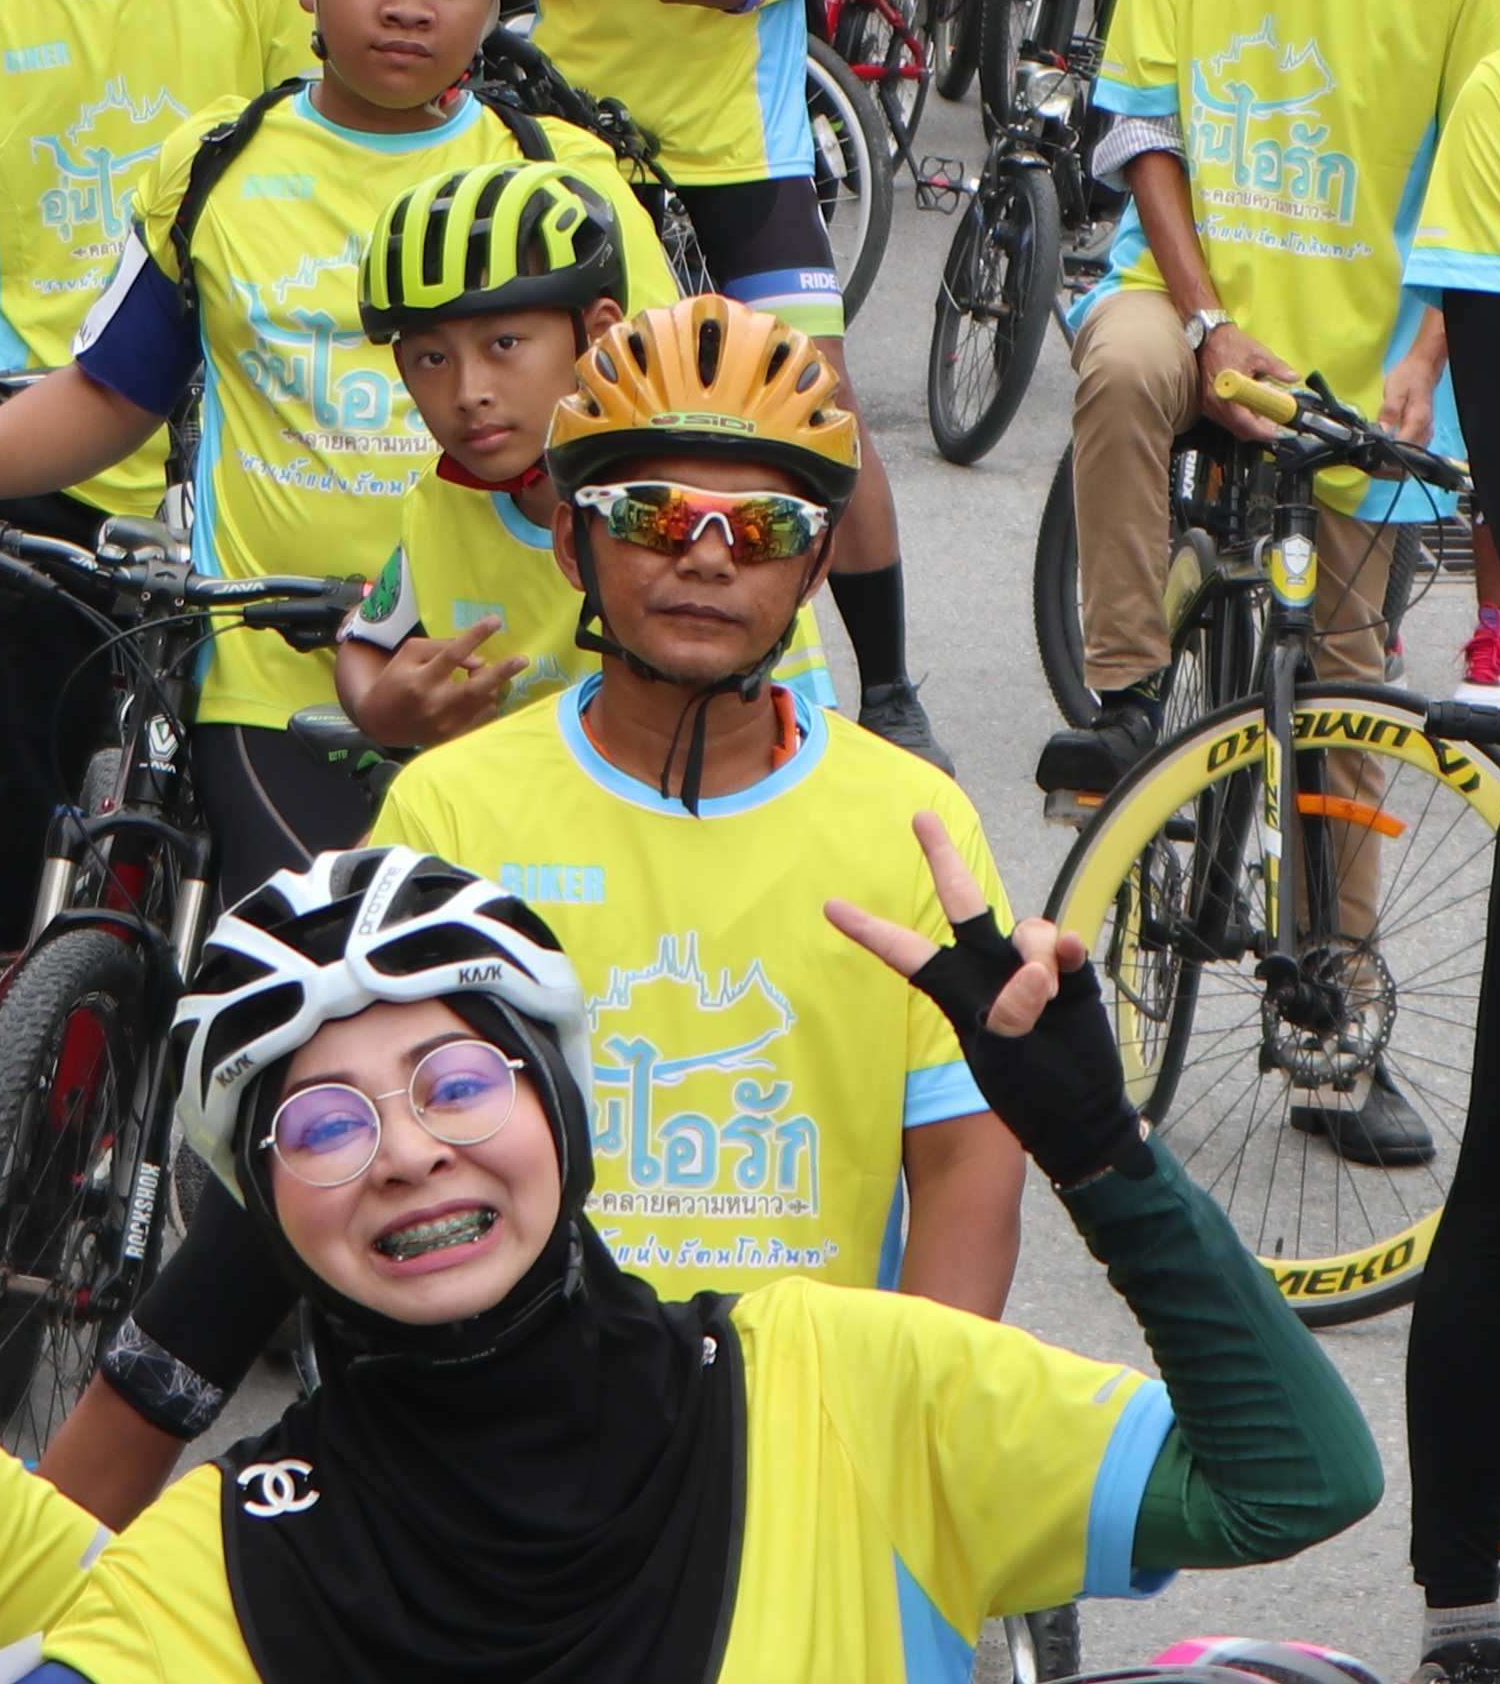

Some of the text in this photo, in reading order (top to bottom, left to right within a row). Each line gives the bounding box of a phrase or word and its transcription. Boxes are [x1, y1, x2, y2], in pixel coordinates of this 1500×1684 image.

[3, 41, 73, 74] BIKER
[1211, 186, 1325, 223] คลายความหนาว
[237, 310, 430, 429] อุ่นไอ
[685, 414, 757, 434] SIDI
[212, 581, 265, 595] JAVA
[500, 863, 607, 904] BIKER
[356, 866, 402, 939] protone
[458, 963, 504, 985] KASK
[215, 1052, 256, 1089] KASK
[124, 1161, 162, 1260] ROCKSHOX
[602, 1188, 784, 1221] คลายความหนาว
[1275, 1235, 1416, 1298] MEKO
